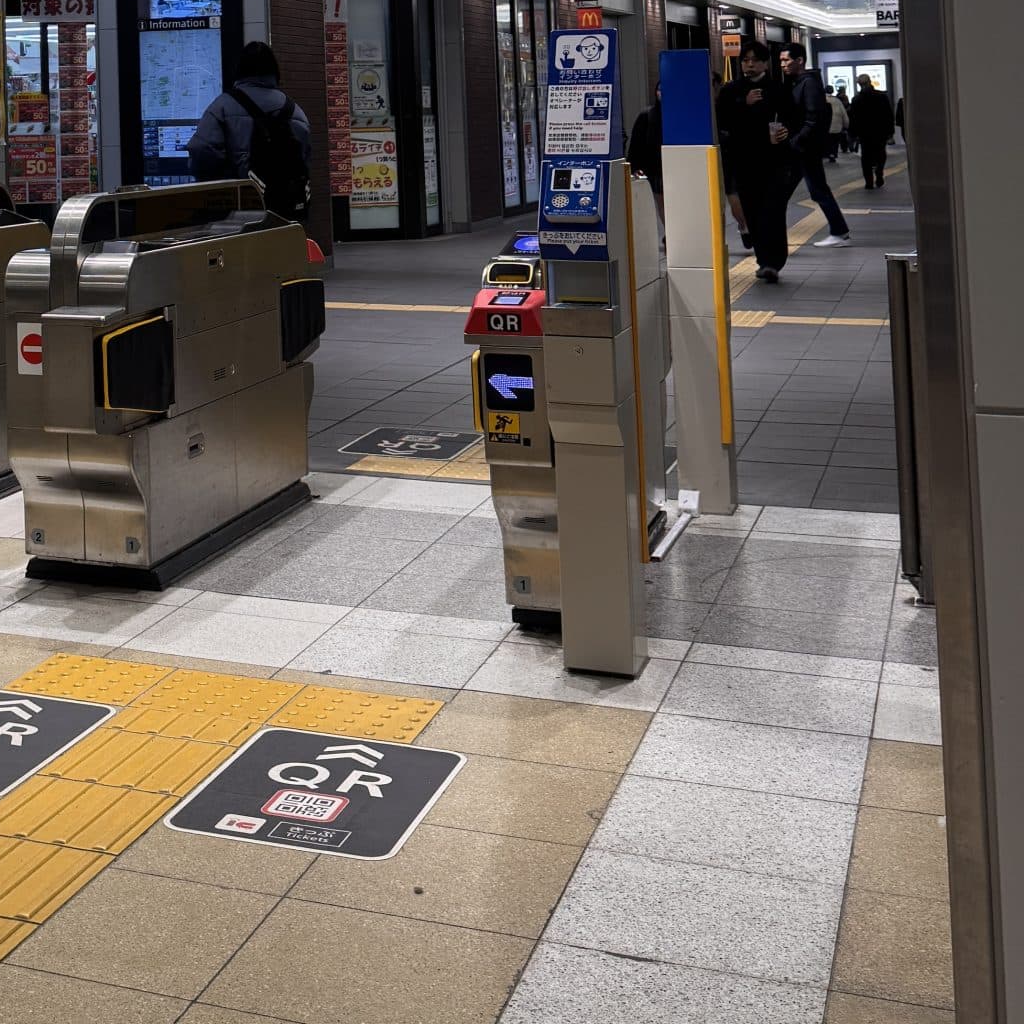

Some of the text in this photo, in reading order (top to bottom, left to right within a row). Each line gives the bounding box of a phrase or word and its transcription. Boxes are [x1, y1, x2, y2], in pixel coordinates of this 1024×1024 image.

[149, 19, 206, 29] Information
[490, 314, 519, 331] QR
[267, 762, 394, 798] QR
[286, 831, 330, 843] Tickets
